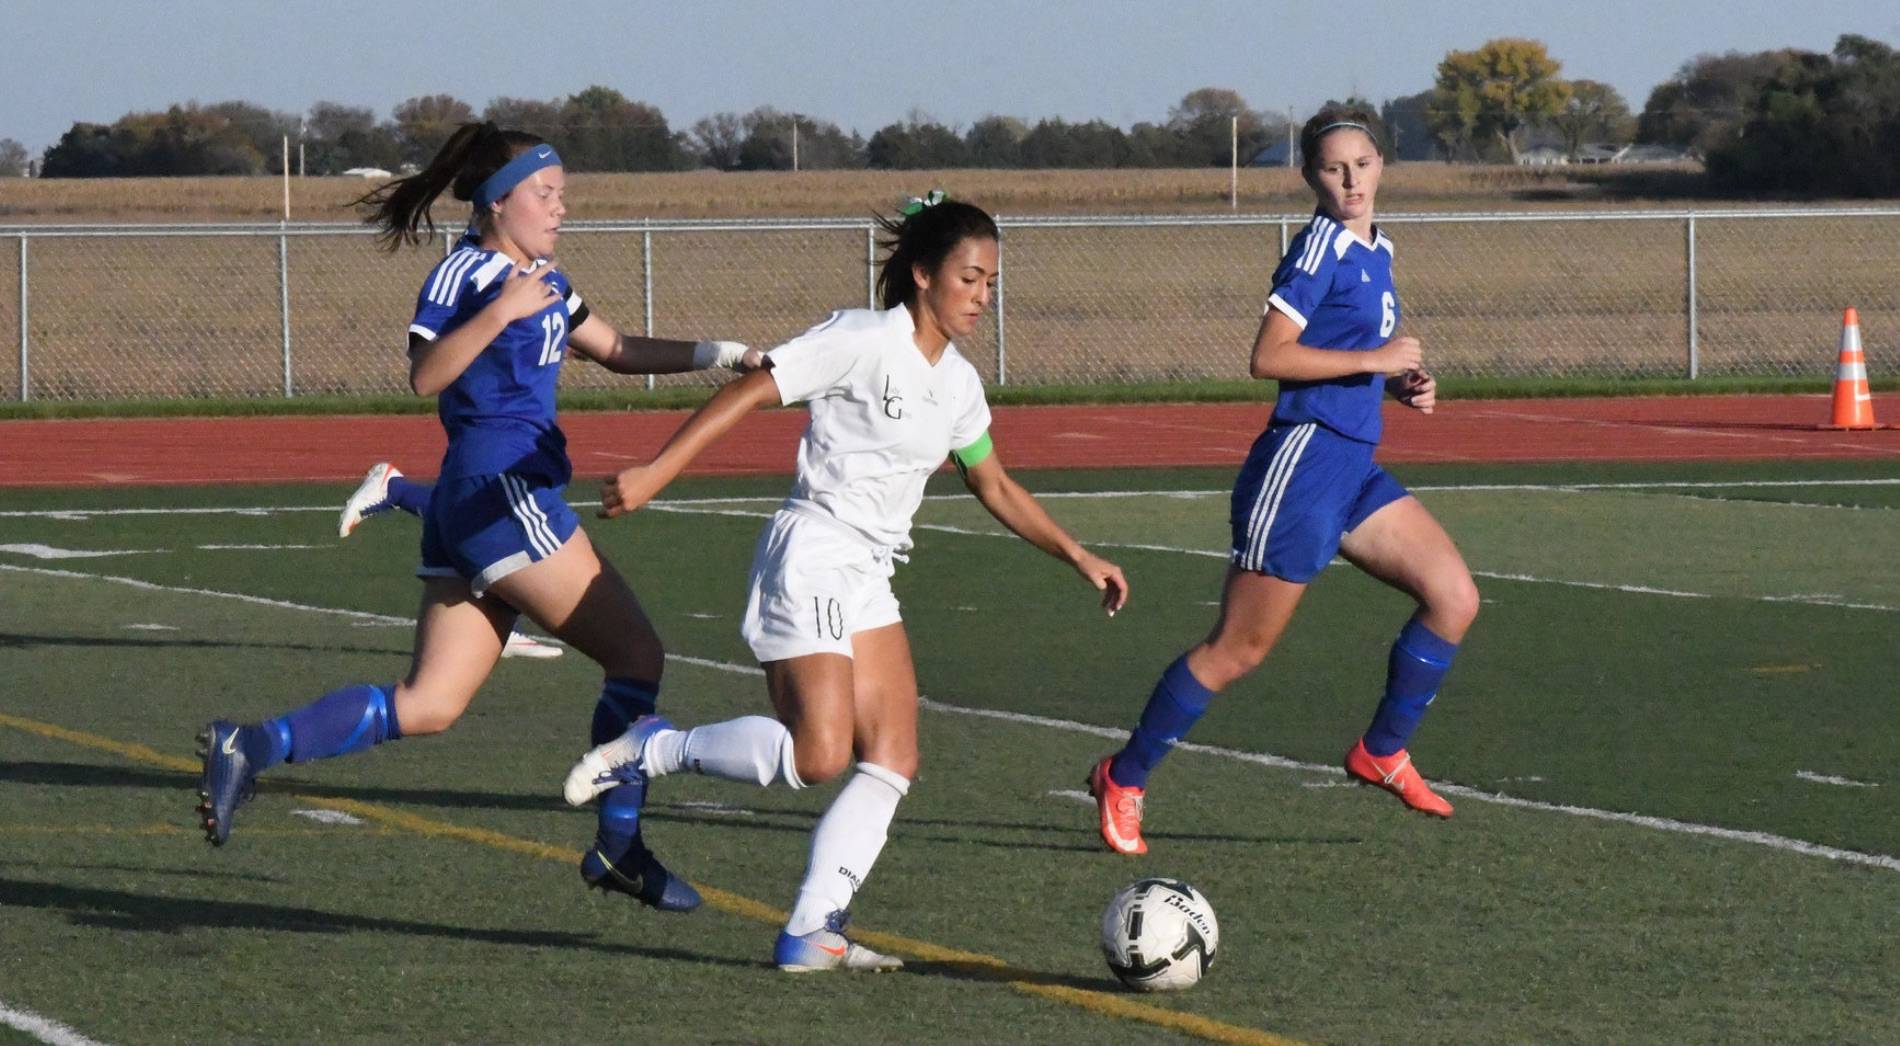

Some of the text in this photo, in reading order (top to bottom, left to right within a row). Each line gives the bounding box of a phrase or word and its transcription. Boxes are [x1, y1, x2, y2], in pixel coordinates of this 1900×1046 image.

[1380, 291, 1396, 338] 6
[538, 312, 565, 366] 12
[814, 596, 844, 641] 10
[1163, 894, 1211, 935] Baden
